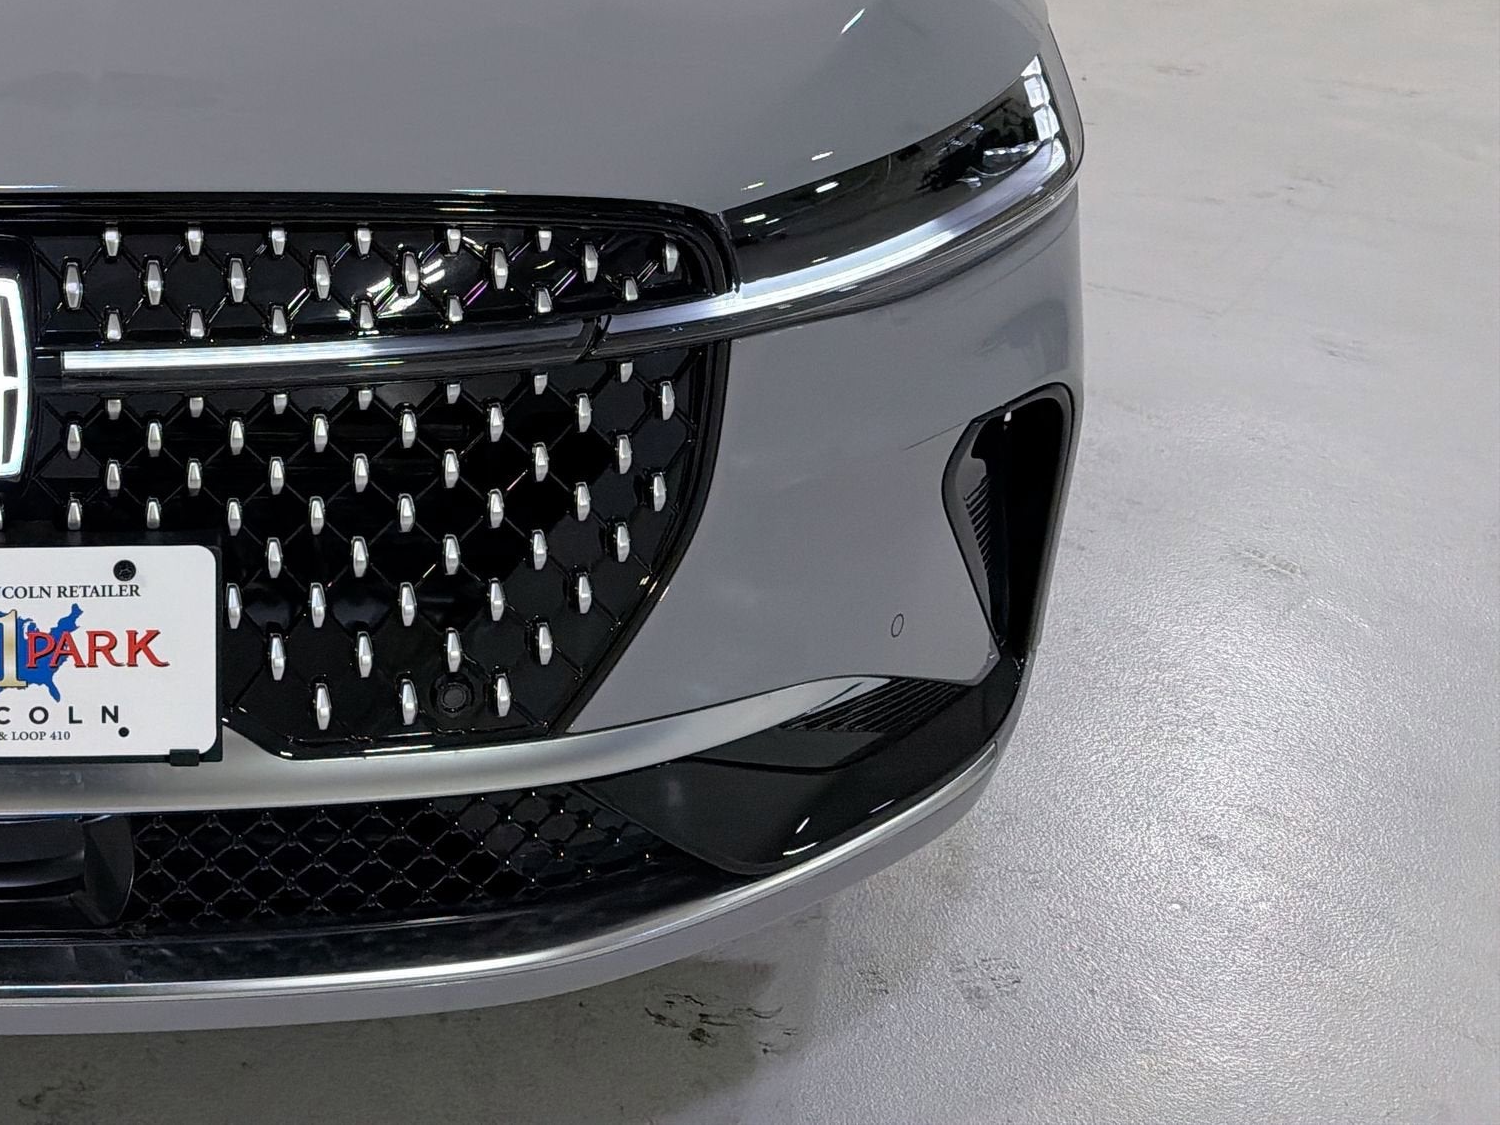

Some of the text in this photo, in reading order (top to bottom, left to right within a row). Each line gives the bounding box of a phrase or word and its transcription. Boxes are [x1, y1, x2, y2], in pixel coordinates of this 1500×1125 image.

[56, 584, 141, 599] RETAILER
[26, 630, 171, 669] PARK
[12, 731, 47, 741] LOOP
[49, 731, 71, 741] 410
